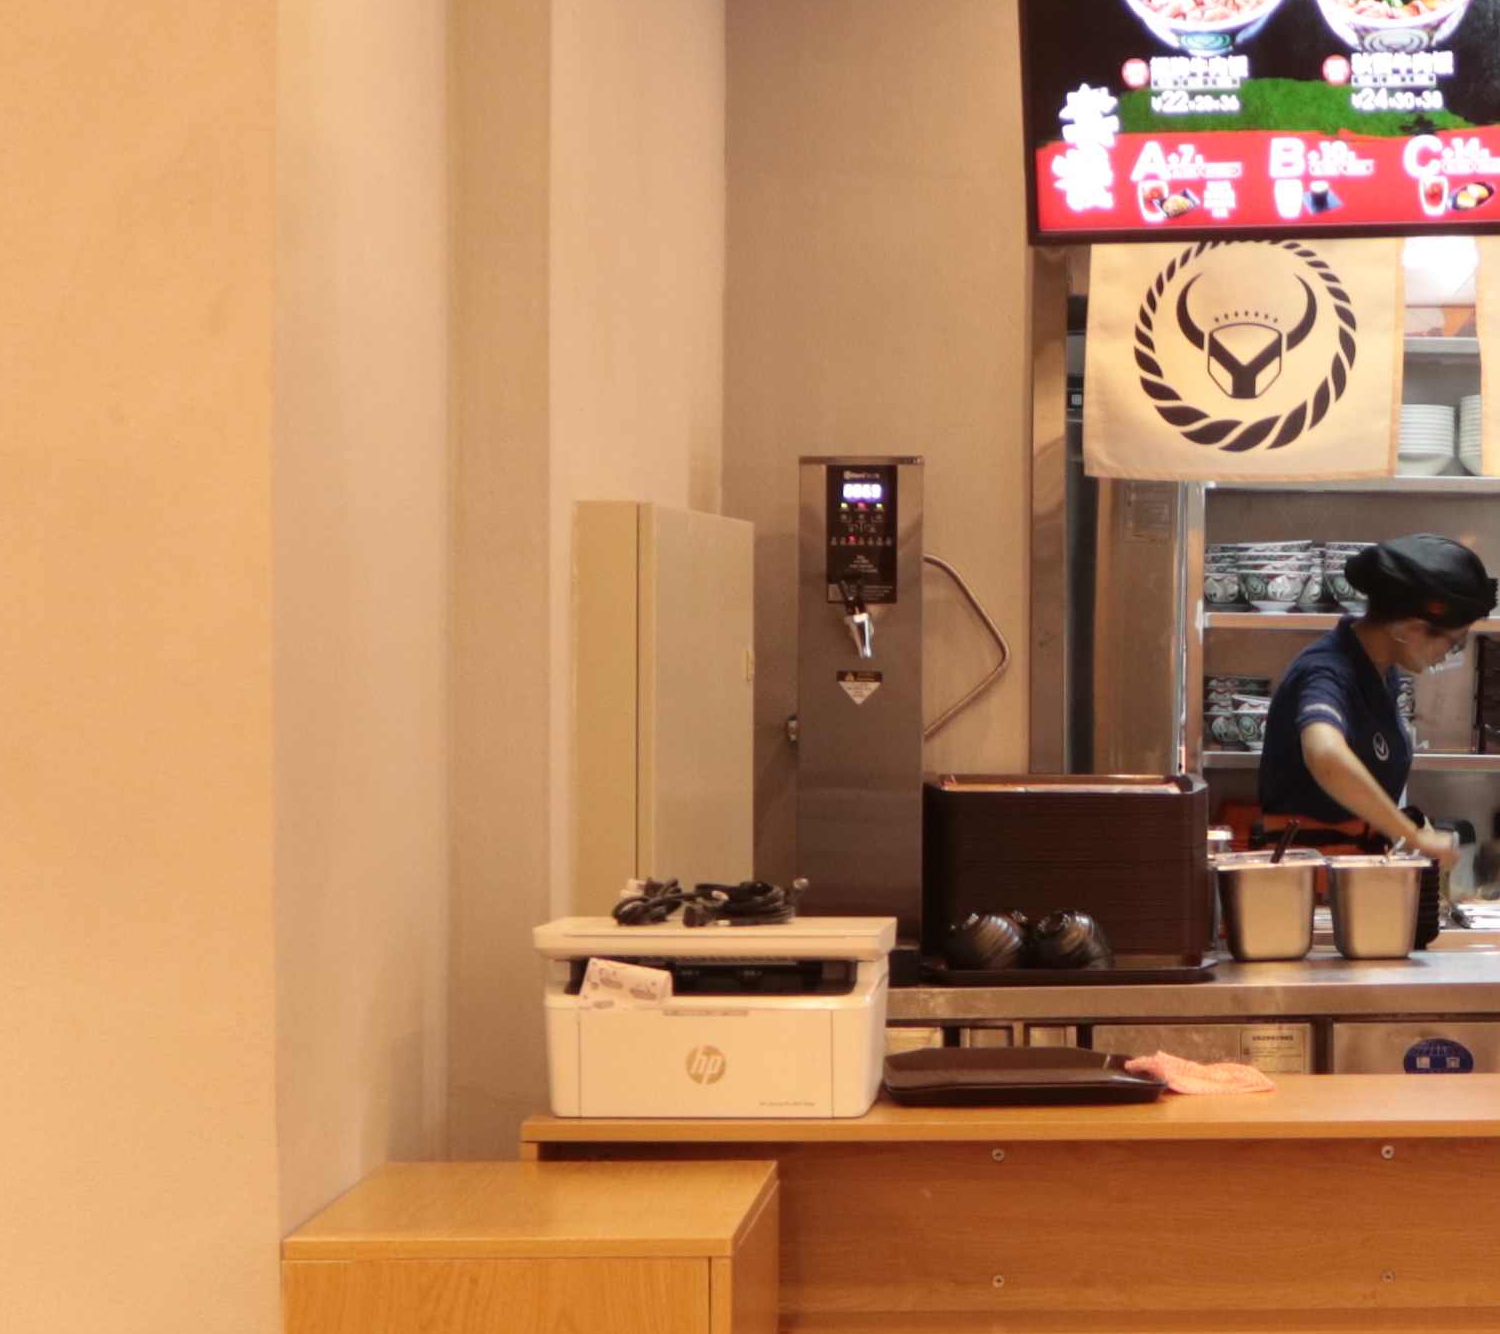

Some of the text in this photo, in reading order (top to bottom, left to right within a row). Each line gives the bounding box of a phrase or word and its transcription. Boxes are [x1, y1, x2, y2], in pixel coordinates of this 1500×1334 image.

[1152, 90, 1188, 112] ¥22
[1352, 86, 1388, 110] ¥24
[1131, 142, 1170, 181] A
[1270, 138, 1306, 178] B
[1404, 135, 1442, 178] C
[690, 1046, 723, 1084] hp
